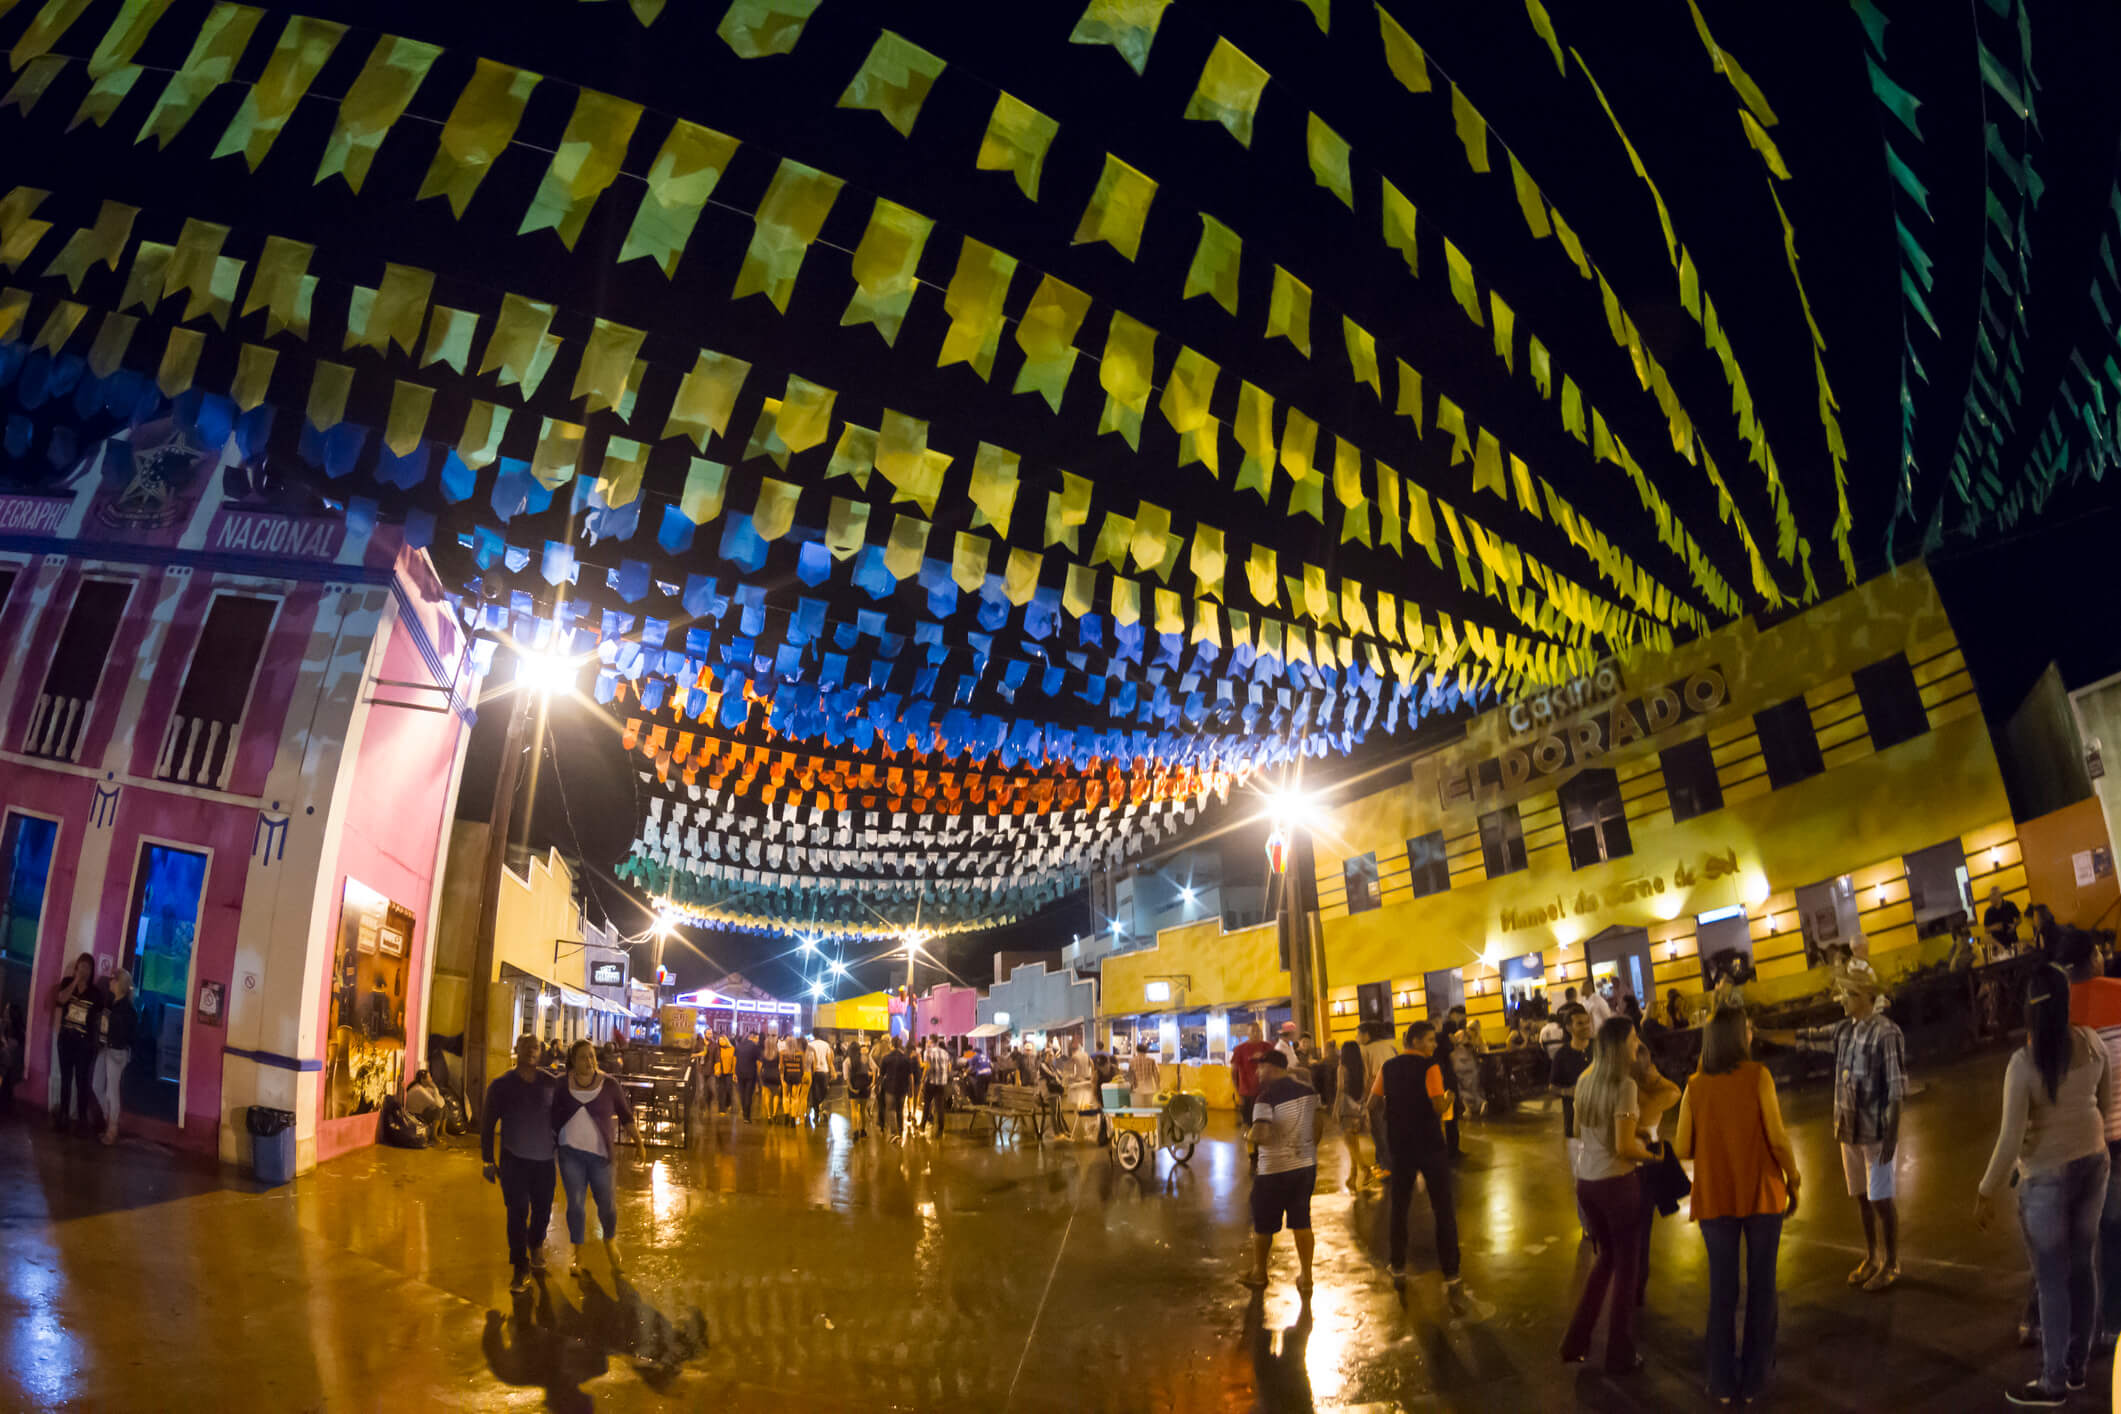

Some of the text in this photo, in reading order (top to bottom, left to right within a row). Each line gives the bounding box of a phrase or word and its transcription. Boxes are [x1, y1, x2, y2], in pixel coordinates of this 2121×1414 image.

[0, 499, 71, 530] EGRAPHO
[216, 515, 334, 557] NACIONAL
[1500, 669, 1726, 787] DORADO
